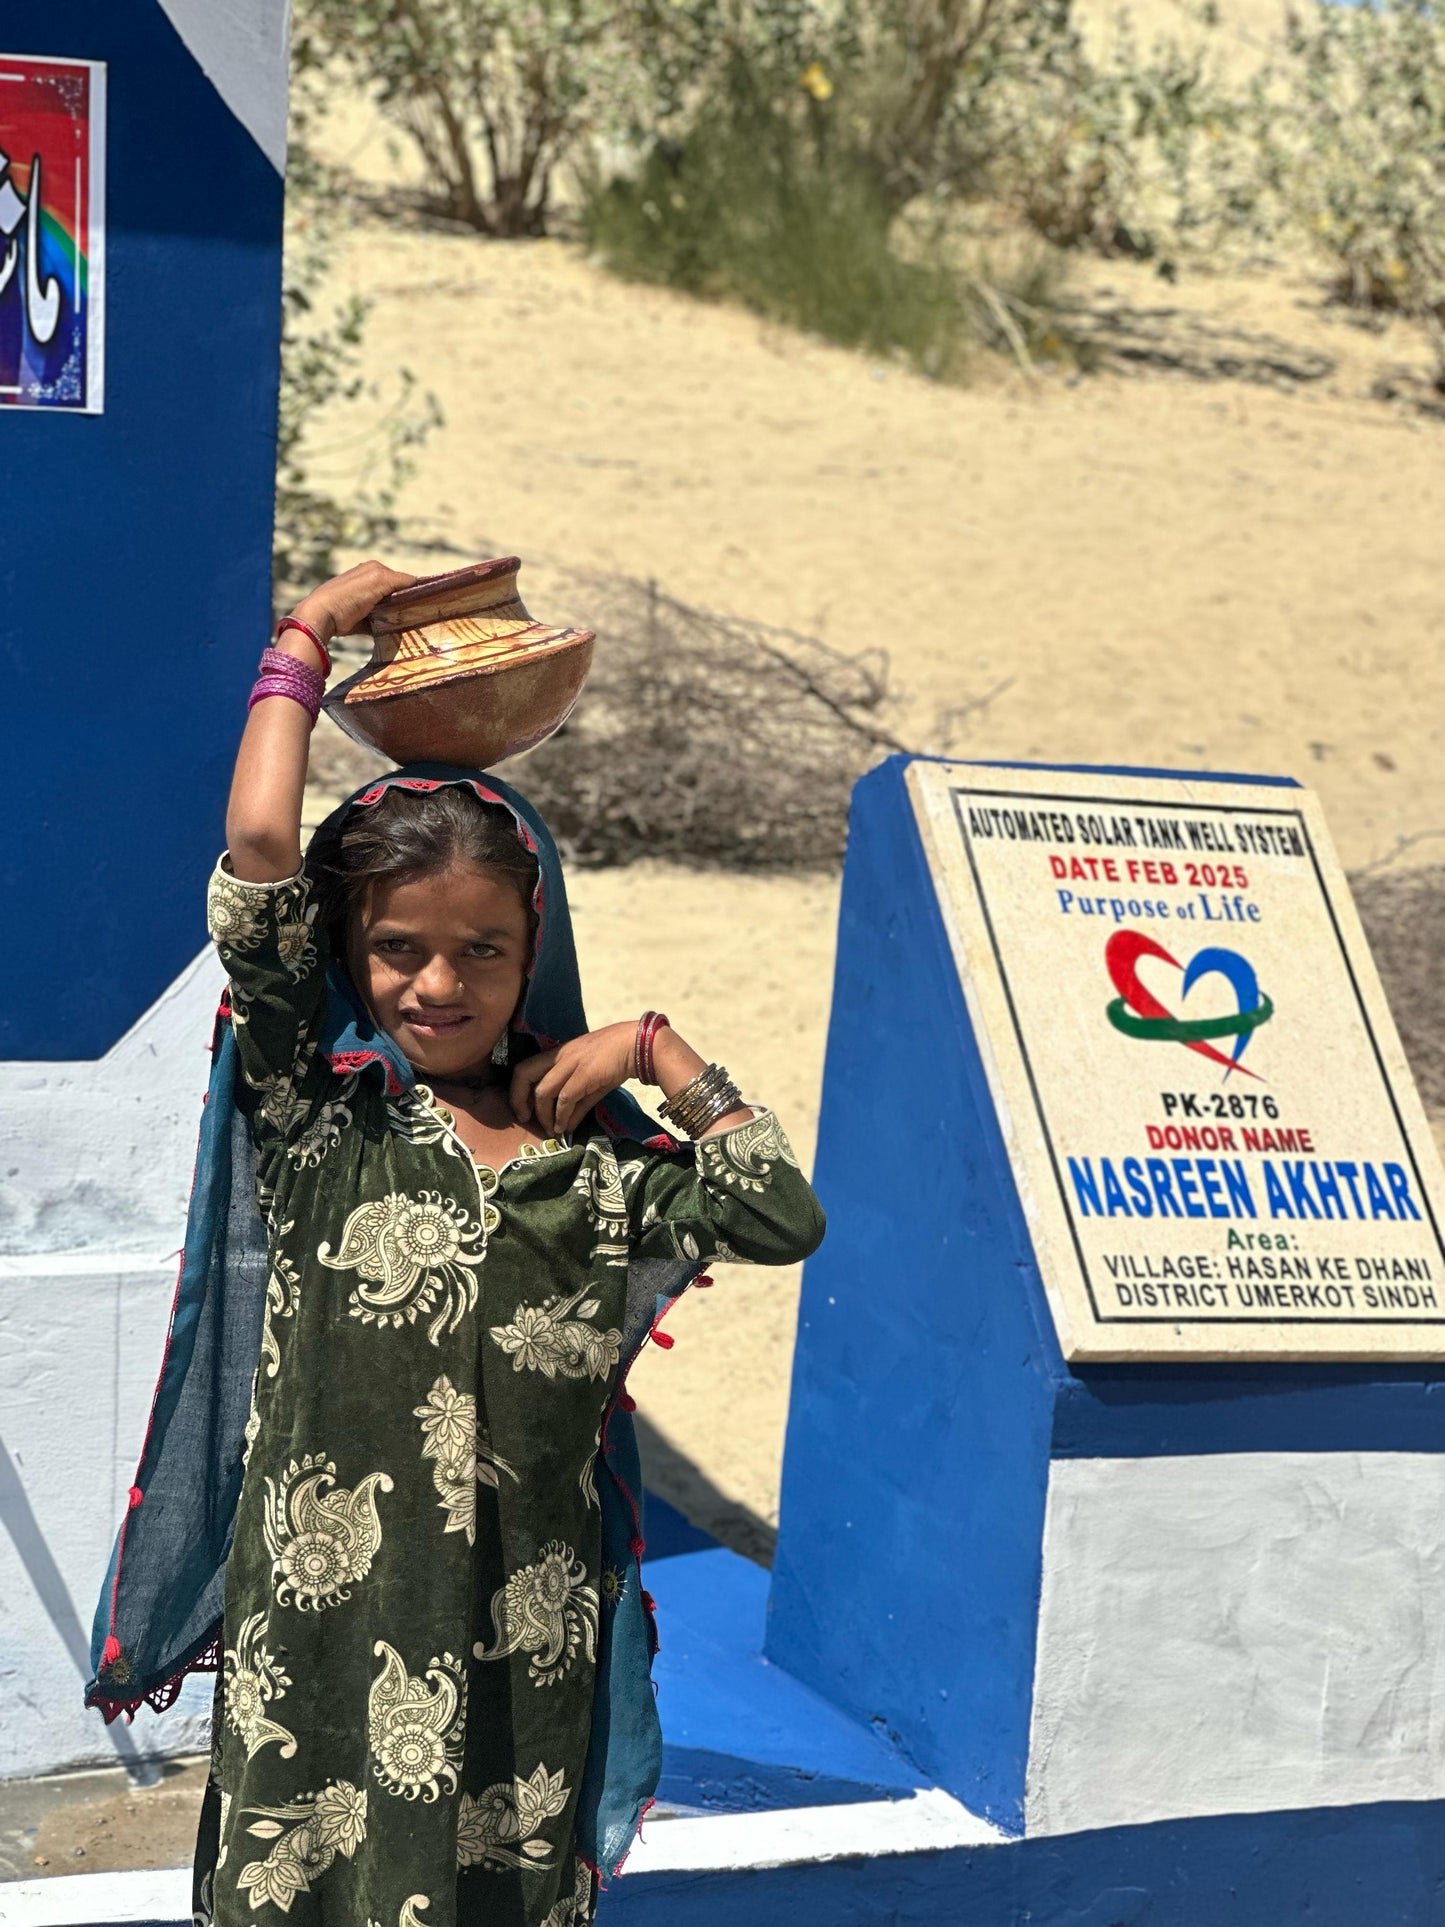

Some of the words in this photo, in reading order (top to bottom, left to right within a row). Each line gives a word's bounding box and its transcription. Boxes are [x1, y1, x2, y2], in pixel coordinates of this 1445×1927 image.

[968, 807, 1074, 844] AUTOMATED
[1077, 814, 1135, 848] SOLAR
[1135, 818, 1186, 850] TANK
[1185, 821, 1234, 853] WELL
[1235, 823, 1305, 857] SYSTEM
[1049, 855, 1120, 883] DATE
[1126, 859, 1178, 885] FEB
[1184, 862, 1249, 889] 2025
[1057, 889, 1170, 922] Purpose
[1177, 903, 1196, 920] of
[1198, 893, 1261, 922] Life
[1161, 1093, 1279, 1119] PK-2876
[1146, 1125, 1238, 1151] DONOR
[1241, 1127, 1315, 1152] NAME
[1067, 1156, 1258, 1219] NASREEN
[1262, 1160, 1422, 1221] AKHTAR
[1227, 1228, 1299, 1250] Area:
[1103, 1255, 1221, 1279] VILLAGE:
[1226, 1256, 1312, 1280] HASAN
[1317, 1258, 1349, 1280] KE
[1355, 1258, 1432, 1281] DHANI
[1115, 1283, 1228, 1307] DISTRICT
[1238, 1285, 1355, 1308] UMERKOT
[1365, 1286, 1438, 1308] SINDH
